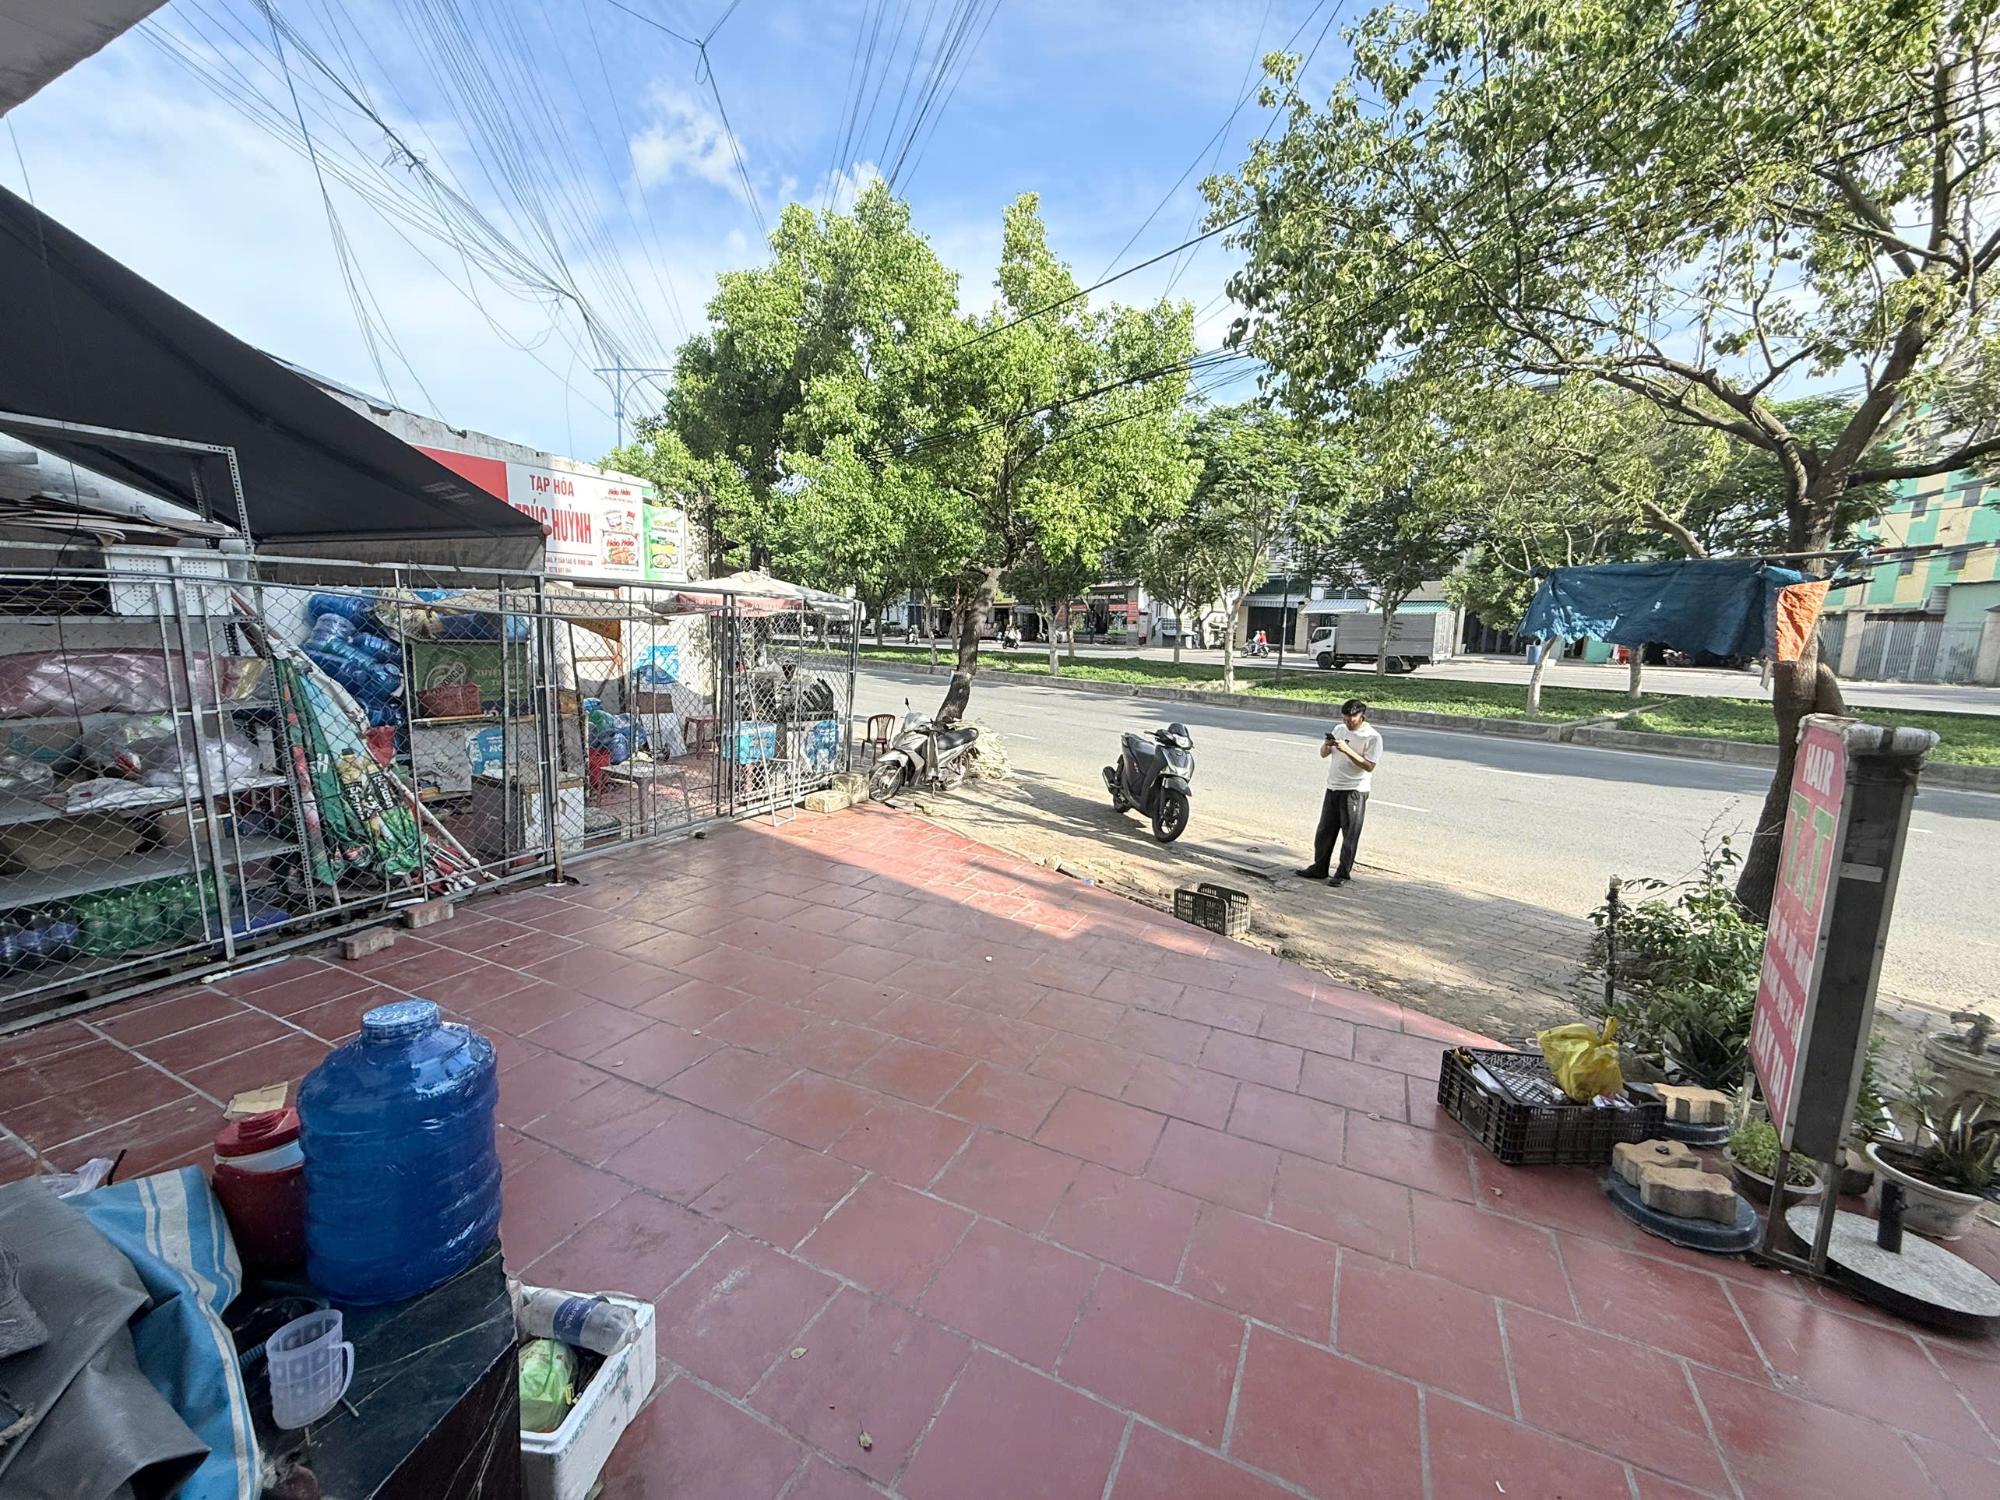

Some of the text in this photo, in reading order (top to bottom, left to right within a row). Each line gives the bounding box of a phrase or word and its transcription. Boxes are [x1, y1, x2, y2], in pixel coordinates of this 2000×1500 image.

[529, 474, 550, 495] TẠP
[607, 538, 634, 547] Hảo Hảo
[1803, 743, 1835, 797] HAIR
